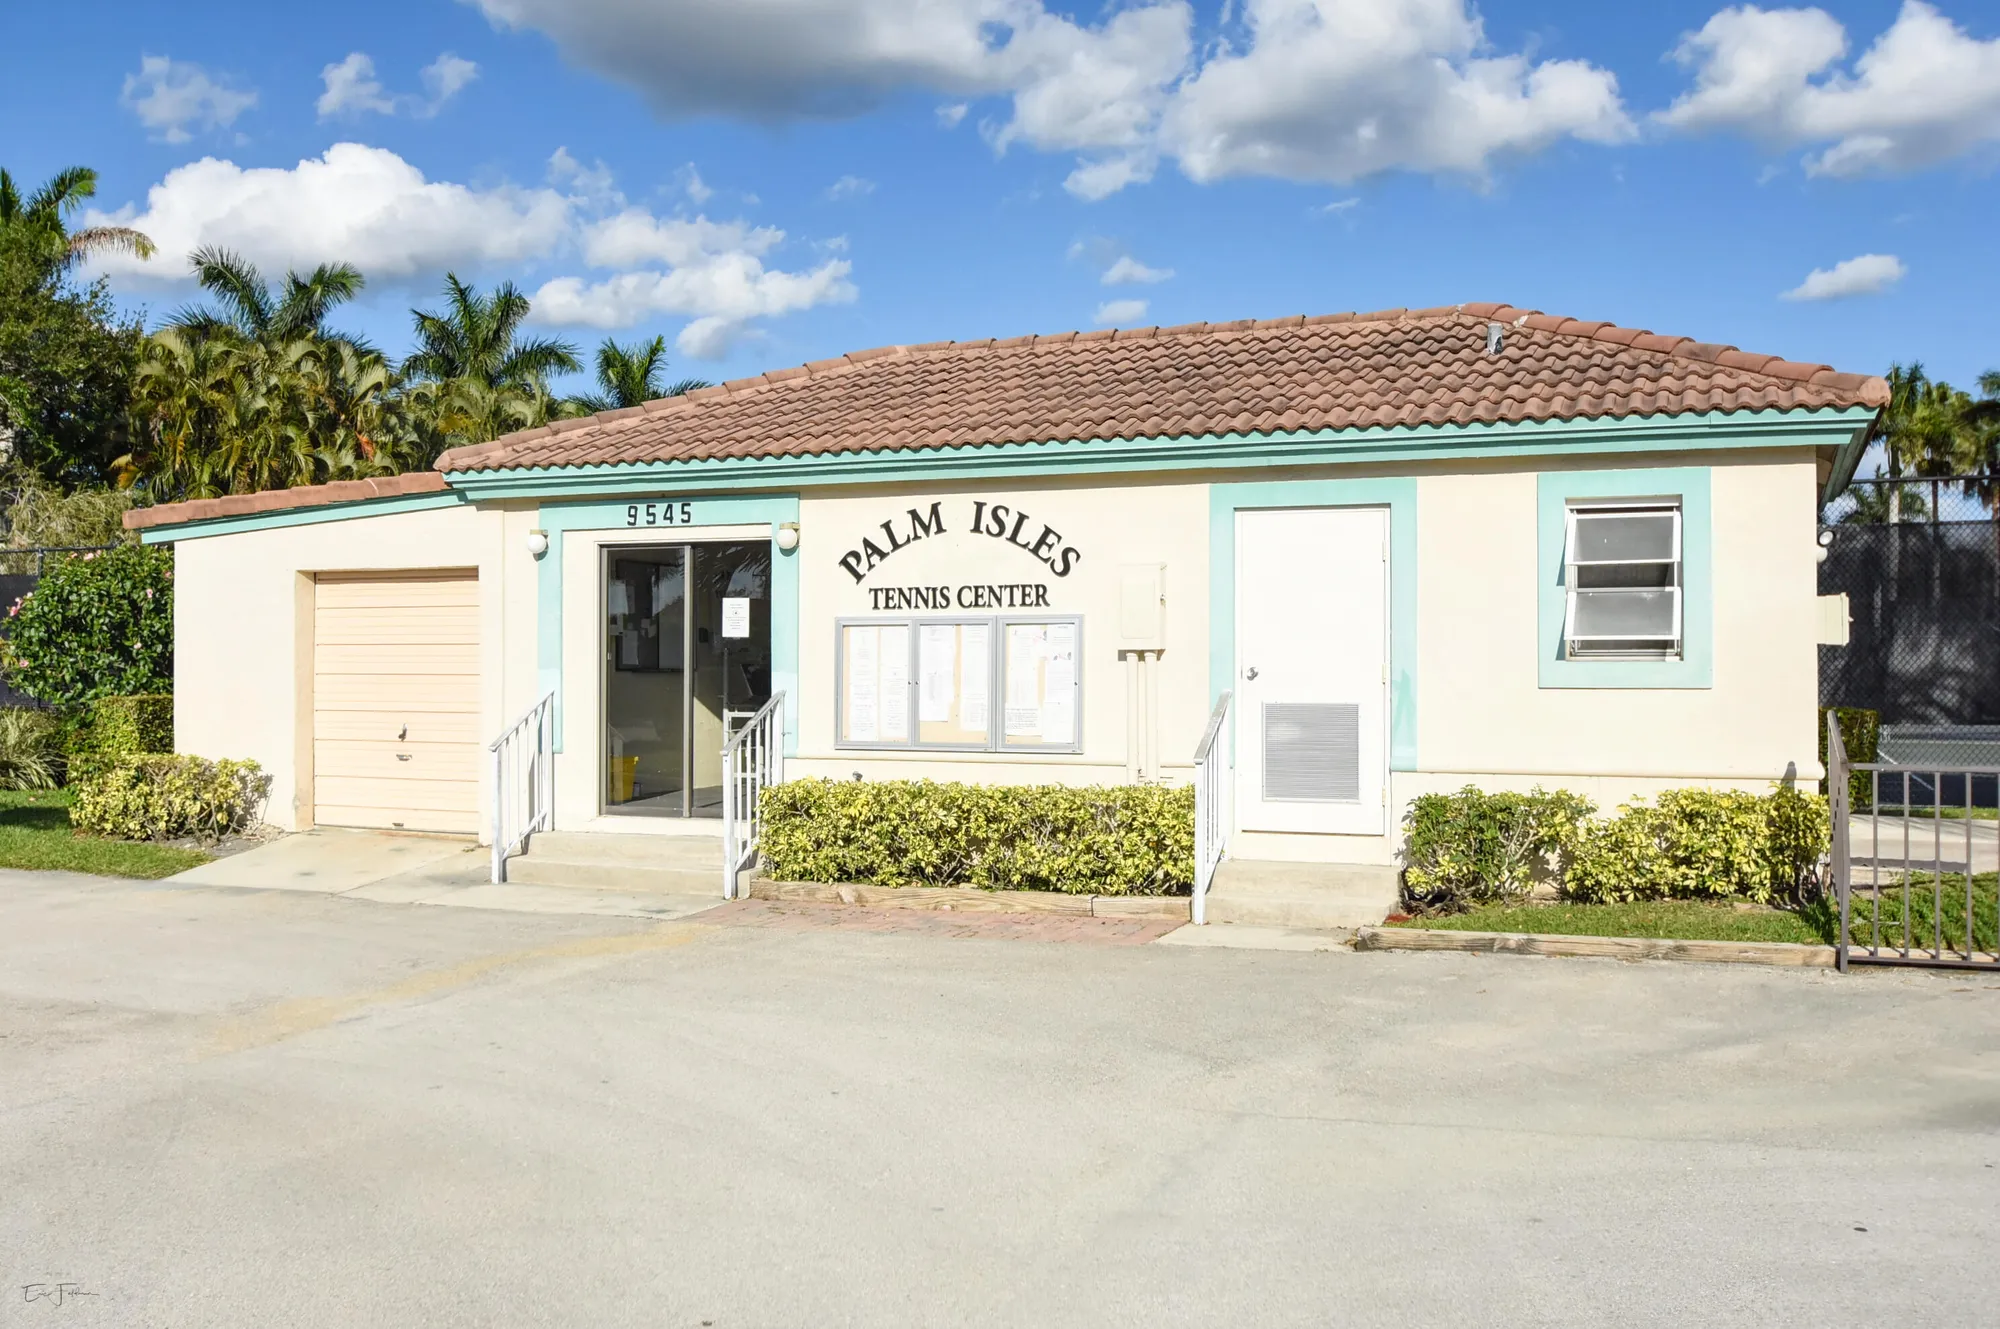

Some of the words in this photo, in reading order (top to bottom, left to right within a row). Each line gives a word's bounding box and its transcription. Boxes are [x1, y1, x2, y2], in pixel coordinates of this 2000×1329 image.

[627, 502, 692, 526] 9545
[838, 501, 947, 585] PALM
[970, 501, 1081, 577] ISLES
[868, 586, 950, 610] TENNIS
[956, 584, 1050, 607] CENTER
